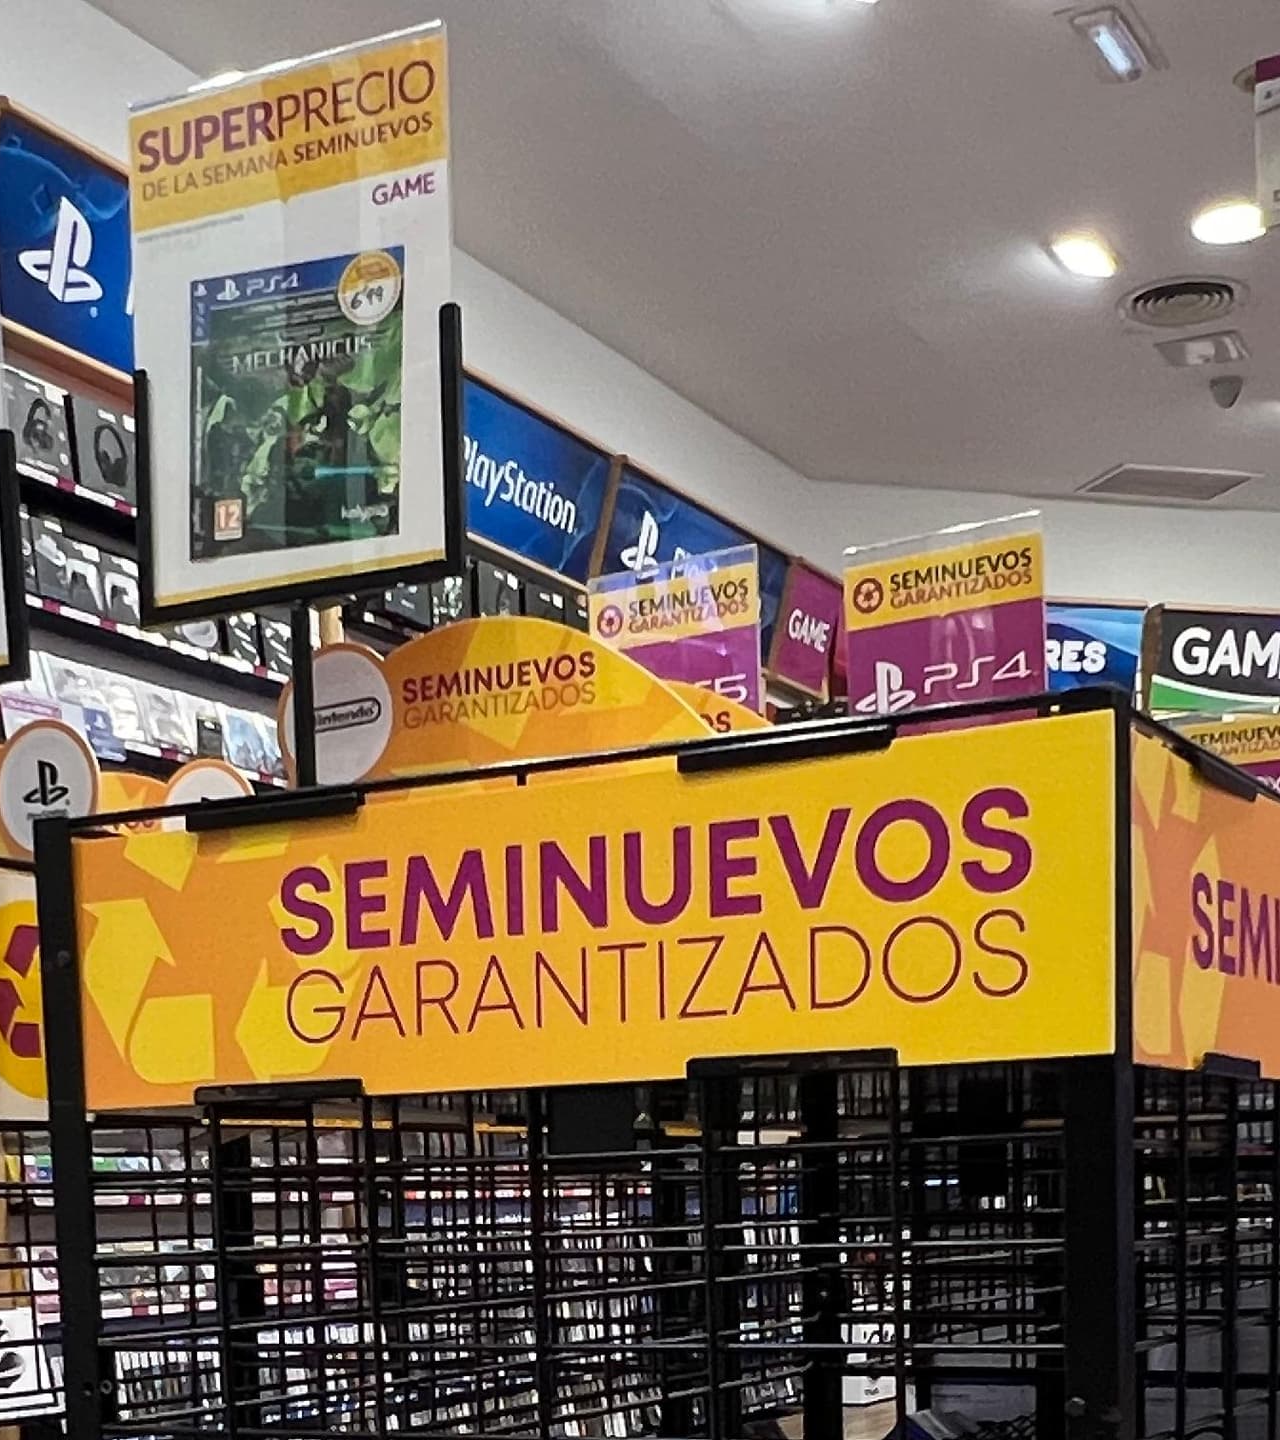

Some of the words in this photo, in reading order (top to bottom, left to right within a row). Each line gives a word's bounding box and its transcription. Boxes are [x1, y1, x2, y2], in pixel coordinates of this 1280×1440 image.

[138, 60, 436, 173] SUPERPRECIO
[142, 177, 169, 202] DE
[174, 172, 199, 194] LA
[203, 150, 288, 188] SEMANA
[293, 111, 433, 165] SEMINUEVOS
[372, 172, 436, 205] GAME
[246, 272, 300, 297] PS4
[232, 335, 372, 373] MECHANICUS
[218, 503, 241, 530] 12
[889, 547, 1032, 593] SEMINUEVOS
[890, 567, 1032, 609] GARANTIZADOS
[628, 577, 749, 618] SEMINUEVOS
[628, 597, 749, 634] GARANTIZADOS
[788, 608, 830, 653] GAME
[402, 652, 597, 704] SEMINUEVOS
[923, 650, 1032, 694] PS4
[318, 702, 374, 725] intendo
[403, 681, 597, 729] GARANTIZADOS
[281, 787, 1033, 956] SEMINUEVOS
[286, 909, 1029, 1045] GARANTIZADOS
